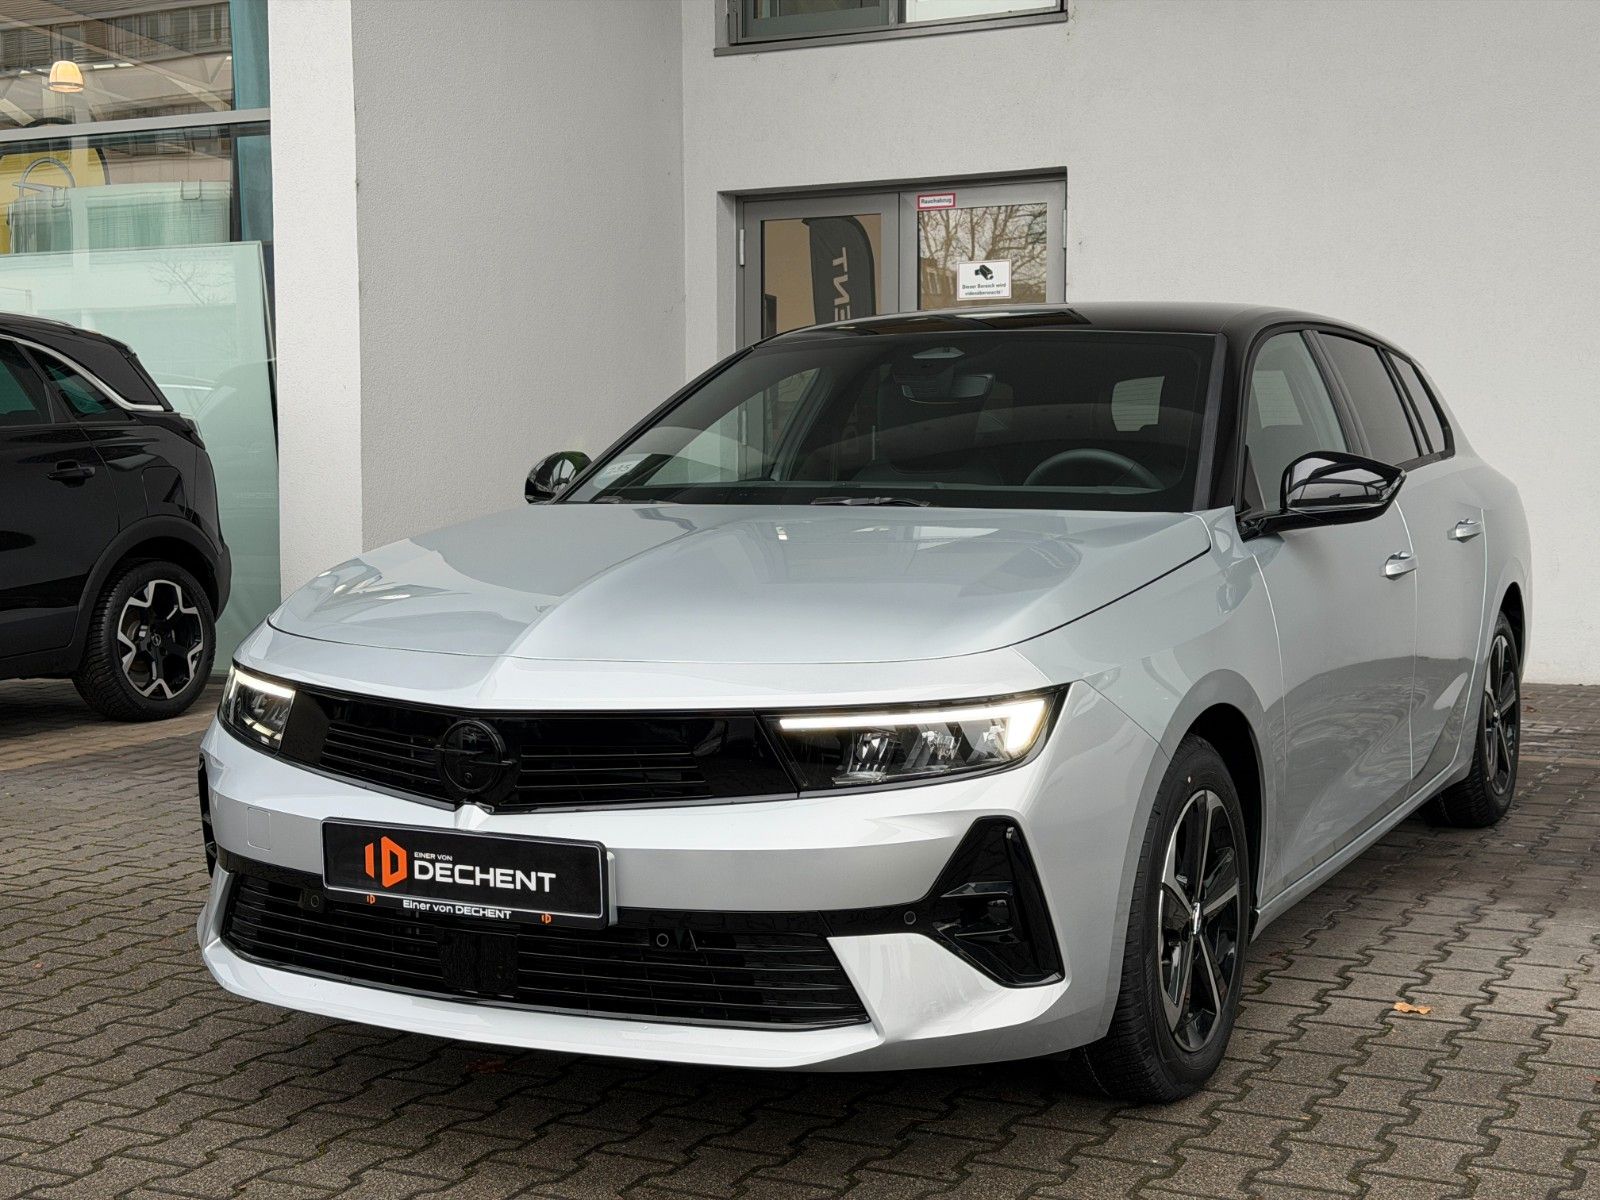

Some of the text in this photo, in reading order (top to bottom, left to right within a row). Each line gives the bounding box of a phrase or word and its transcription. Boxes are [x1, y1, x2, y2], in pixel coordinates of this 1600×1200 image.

[414, 852, 436, 860] EINER
[414, 860, 556, 893] DECHENT
[402, 899, 511, 920] Einer von DECHENT
